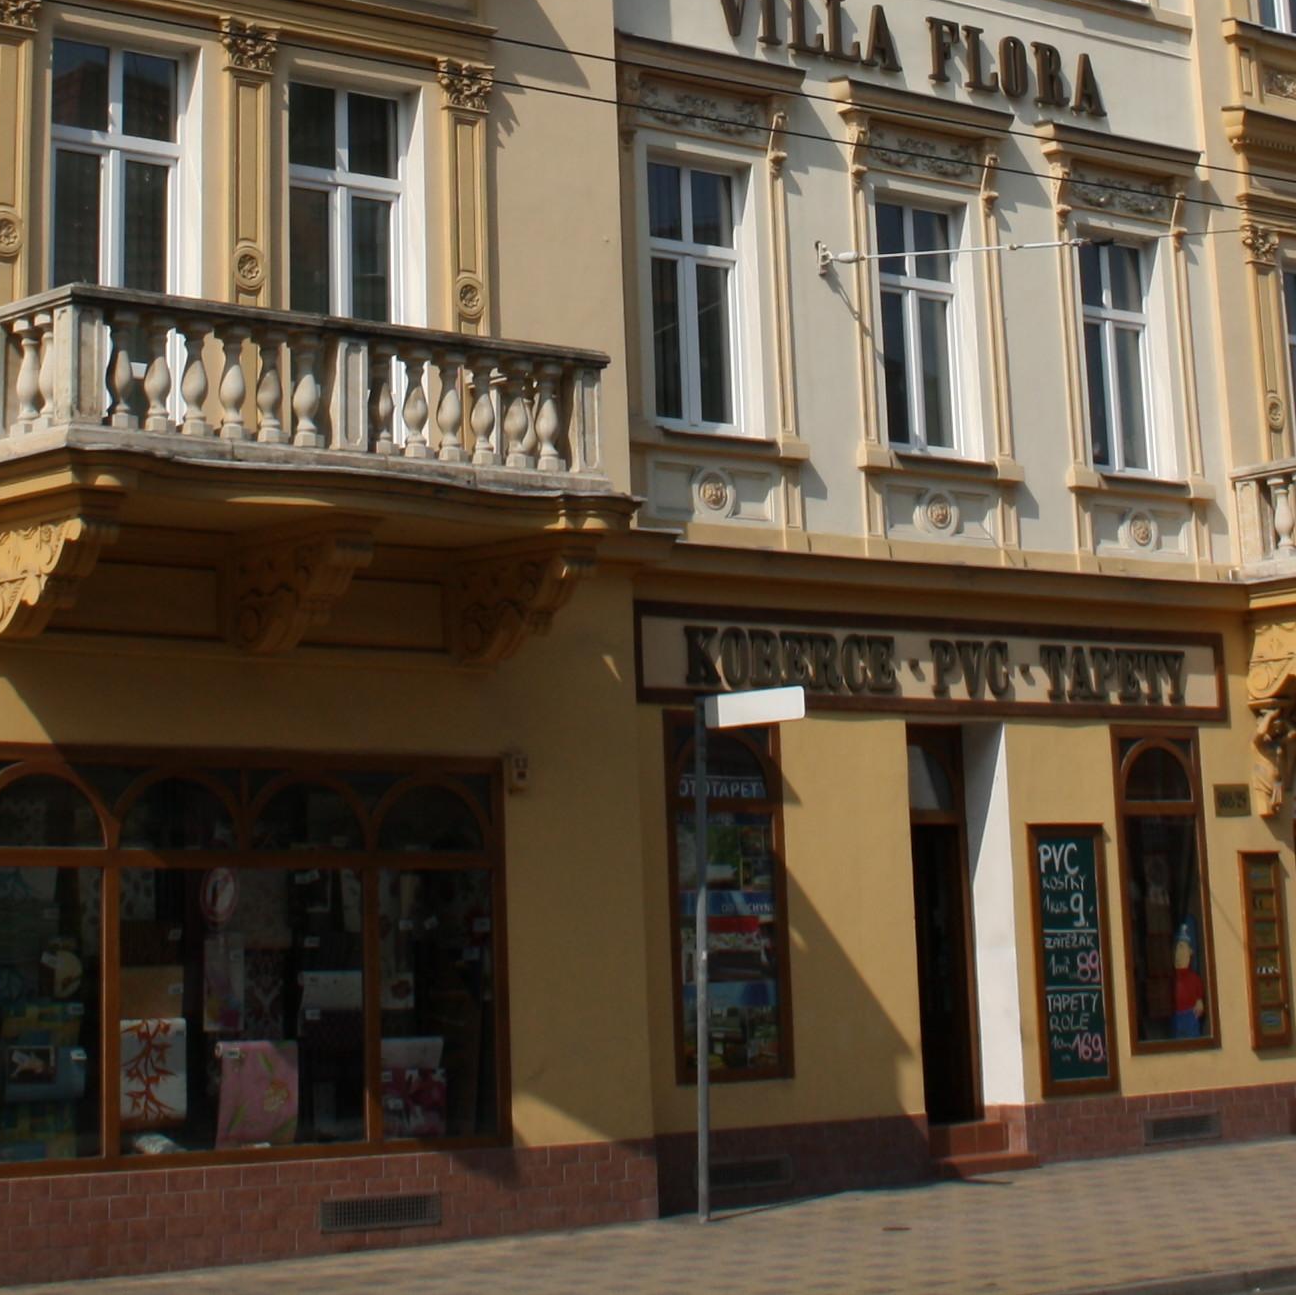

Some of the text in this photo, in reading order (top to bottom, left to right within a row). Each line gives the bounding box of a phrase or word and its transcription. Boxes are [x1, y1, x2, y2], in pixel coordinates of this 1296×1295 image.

[925, 15, 1107, 118] FLORA
[682, 625, 1186, 705] KOBERCE PVC TAPETY
[678, 778, 768, 798] OTOTAPET
[1038, 842, 1080, 876] PVC
[1042, 873, 1086, 891] KOSTKY
[1046, 992, 1099, 1012] TAPETY
[1049, 1012, 1091, 1034] ROLE
